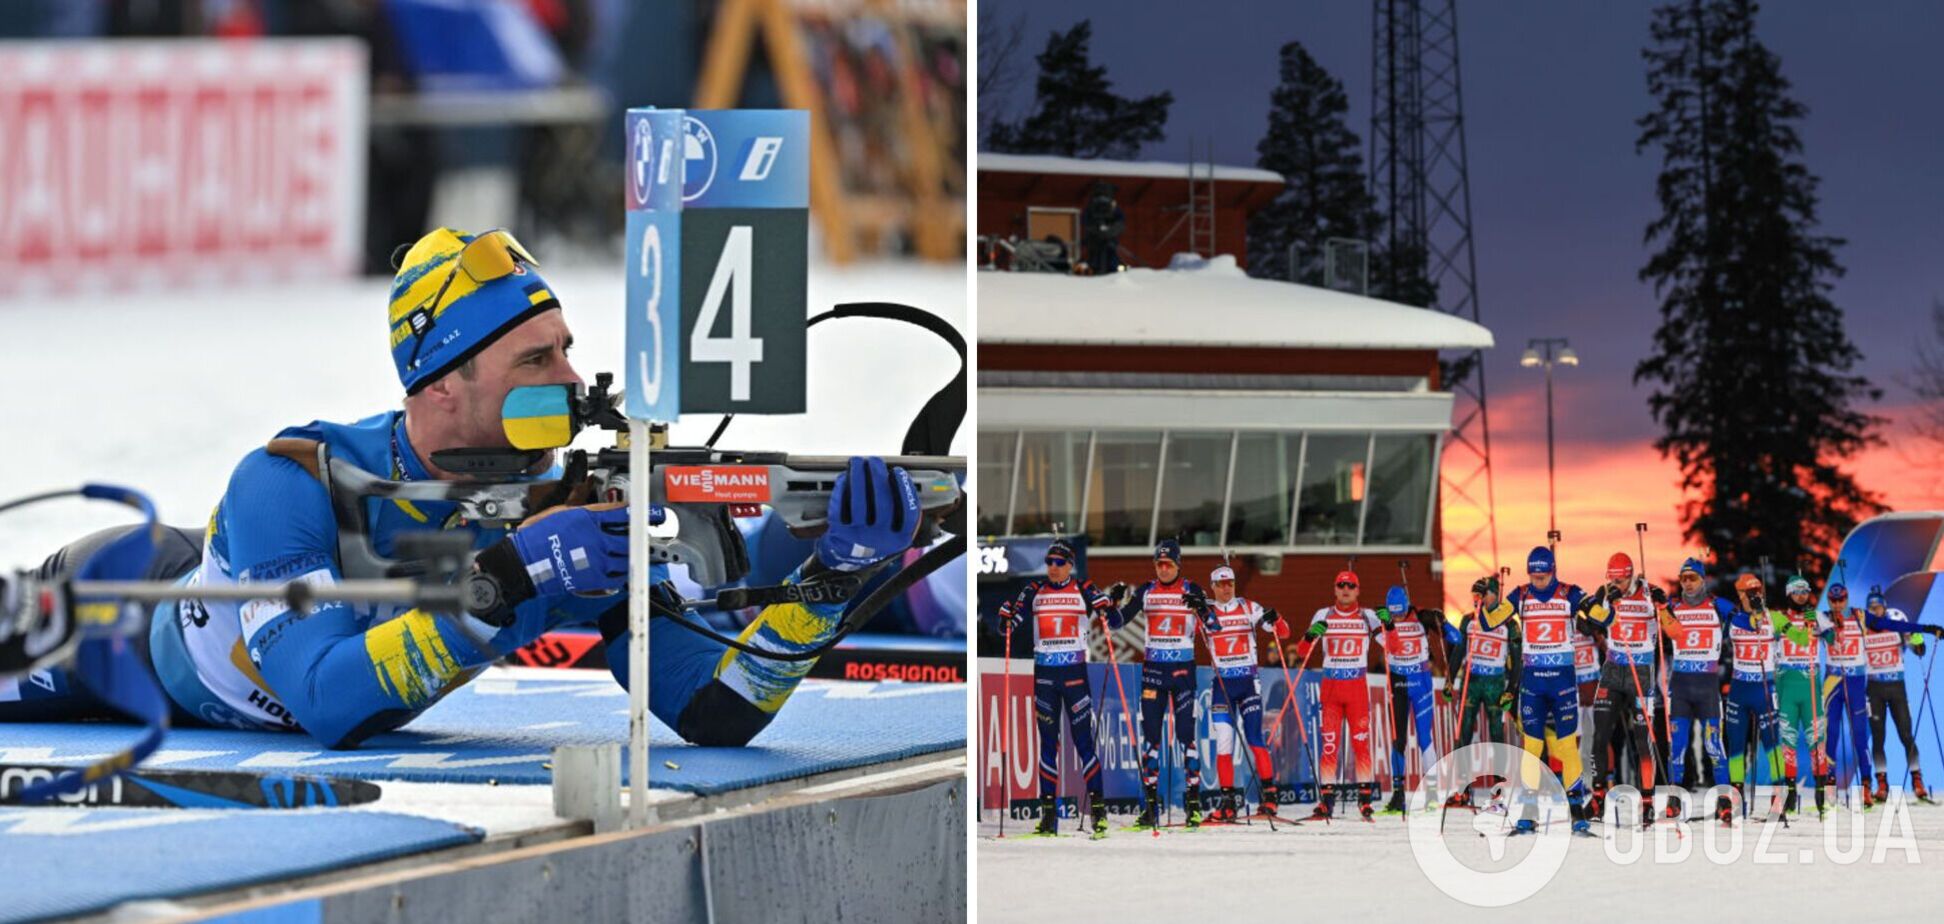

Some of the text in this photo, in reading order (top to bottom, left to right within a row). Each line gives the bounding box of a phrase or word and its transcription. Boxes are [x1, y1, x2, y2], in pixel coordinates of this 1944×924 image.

[0, 84, 334, 264] AUHAUS
[641, 224, 662, 406] 3
[690, 225, 764, 401] 4
[668, 469, 769, 493] VIESSMANN
[548, 534, 577, 591] Roeckl
[1052, 616, 1062, 635] 1
[1158, 615, 1172, 634] 4
[1536, 622, 1552, 641] 2
[1621, 623, 1633, 639] 5
[1224, 637, 1238, 654] 7
[1331, 639, 1355, 655] 10
[1686, 630, 1700, 647] 8
[1402, 641, 1414, 655] 3
[1544, 654, 1564, 665] iX2
[1690, 660, 1708, 672] iX2
[1872, 650, 1892, 665] 20
[845, 662, 963, 683] ROSSIGNOL
[1280, 789, 1314, 802] 20 21
[1013, 806, 1031, 820] 10
[1058, 805, 1077, 818] 12
